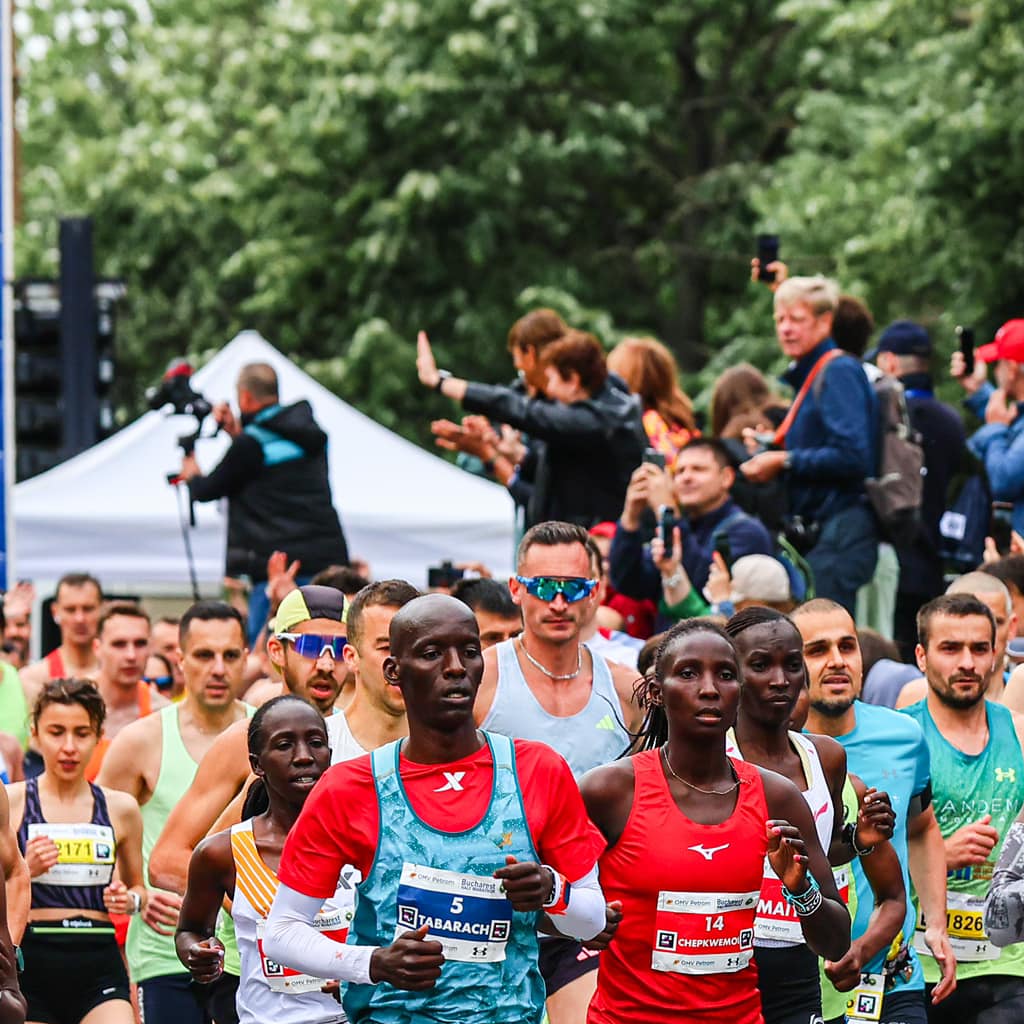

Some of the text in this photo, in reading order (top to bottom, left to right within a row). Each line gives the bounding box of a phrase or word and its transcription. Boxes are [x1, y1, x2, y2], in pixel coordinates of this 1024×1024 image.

[450, 897, 463, 914] 5
[418, 914, 490, 935] TABARACH
[706, 915, 724, 932] 14
[946, 913, 983, 931] 1826
